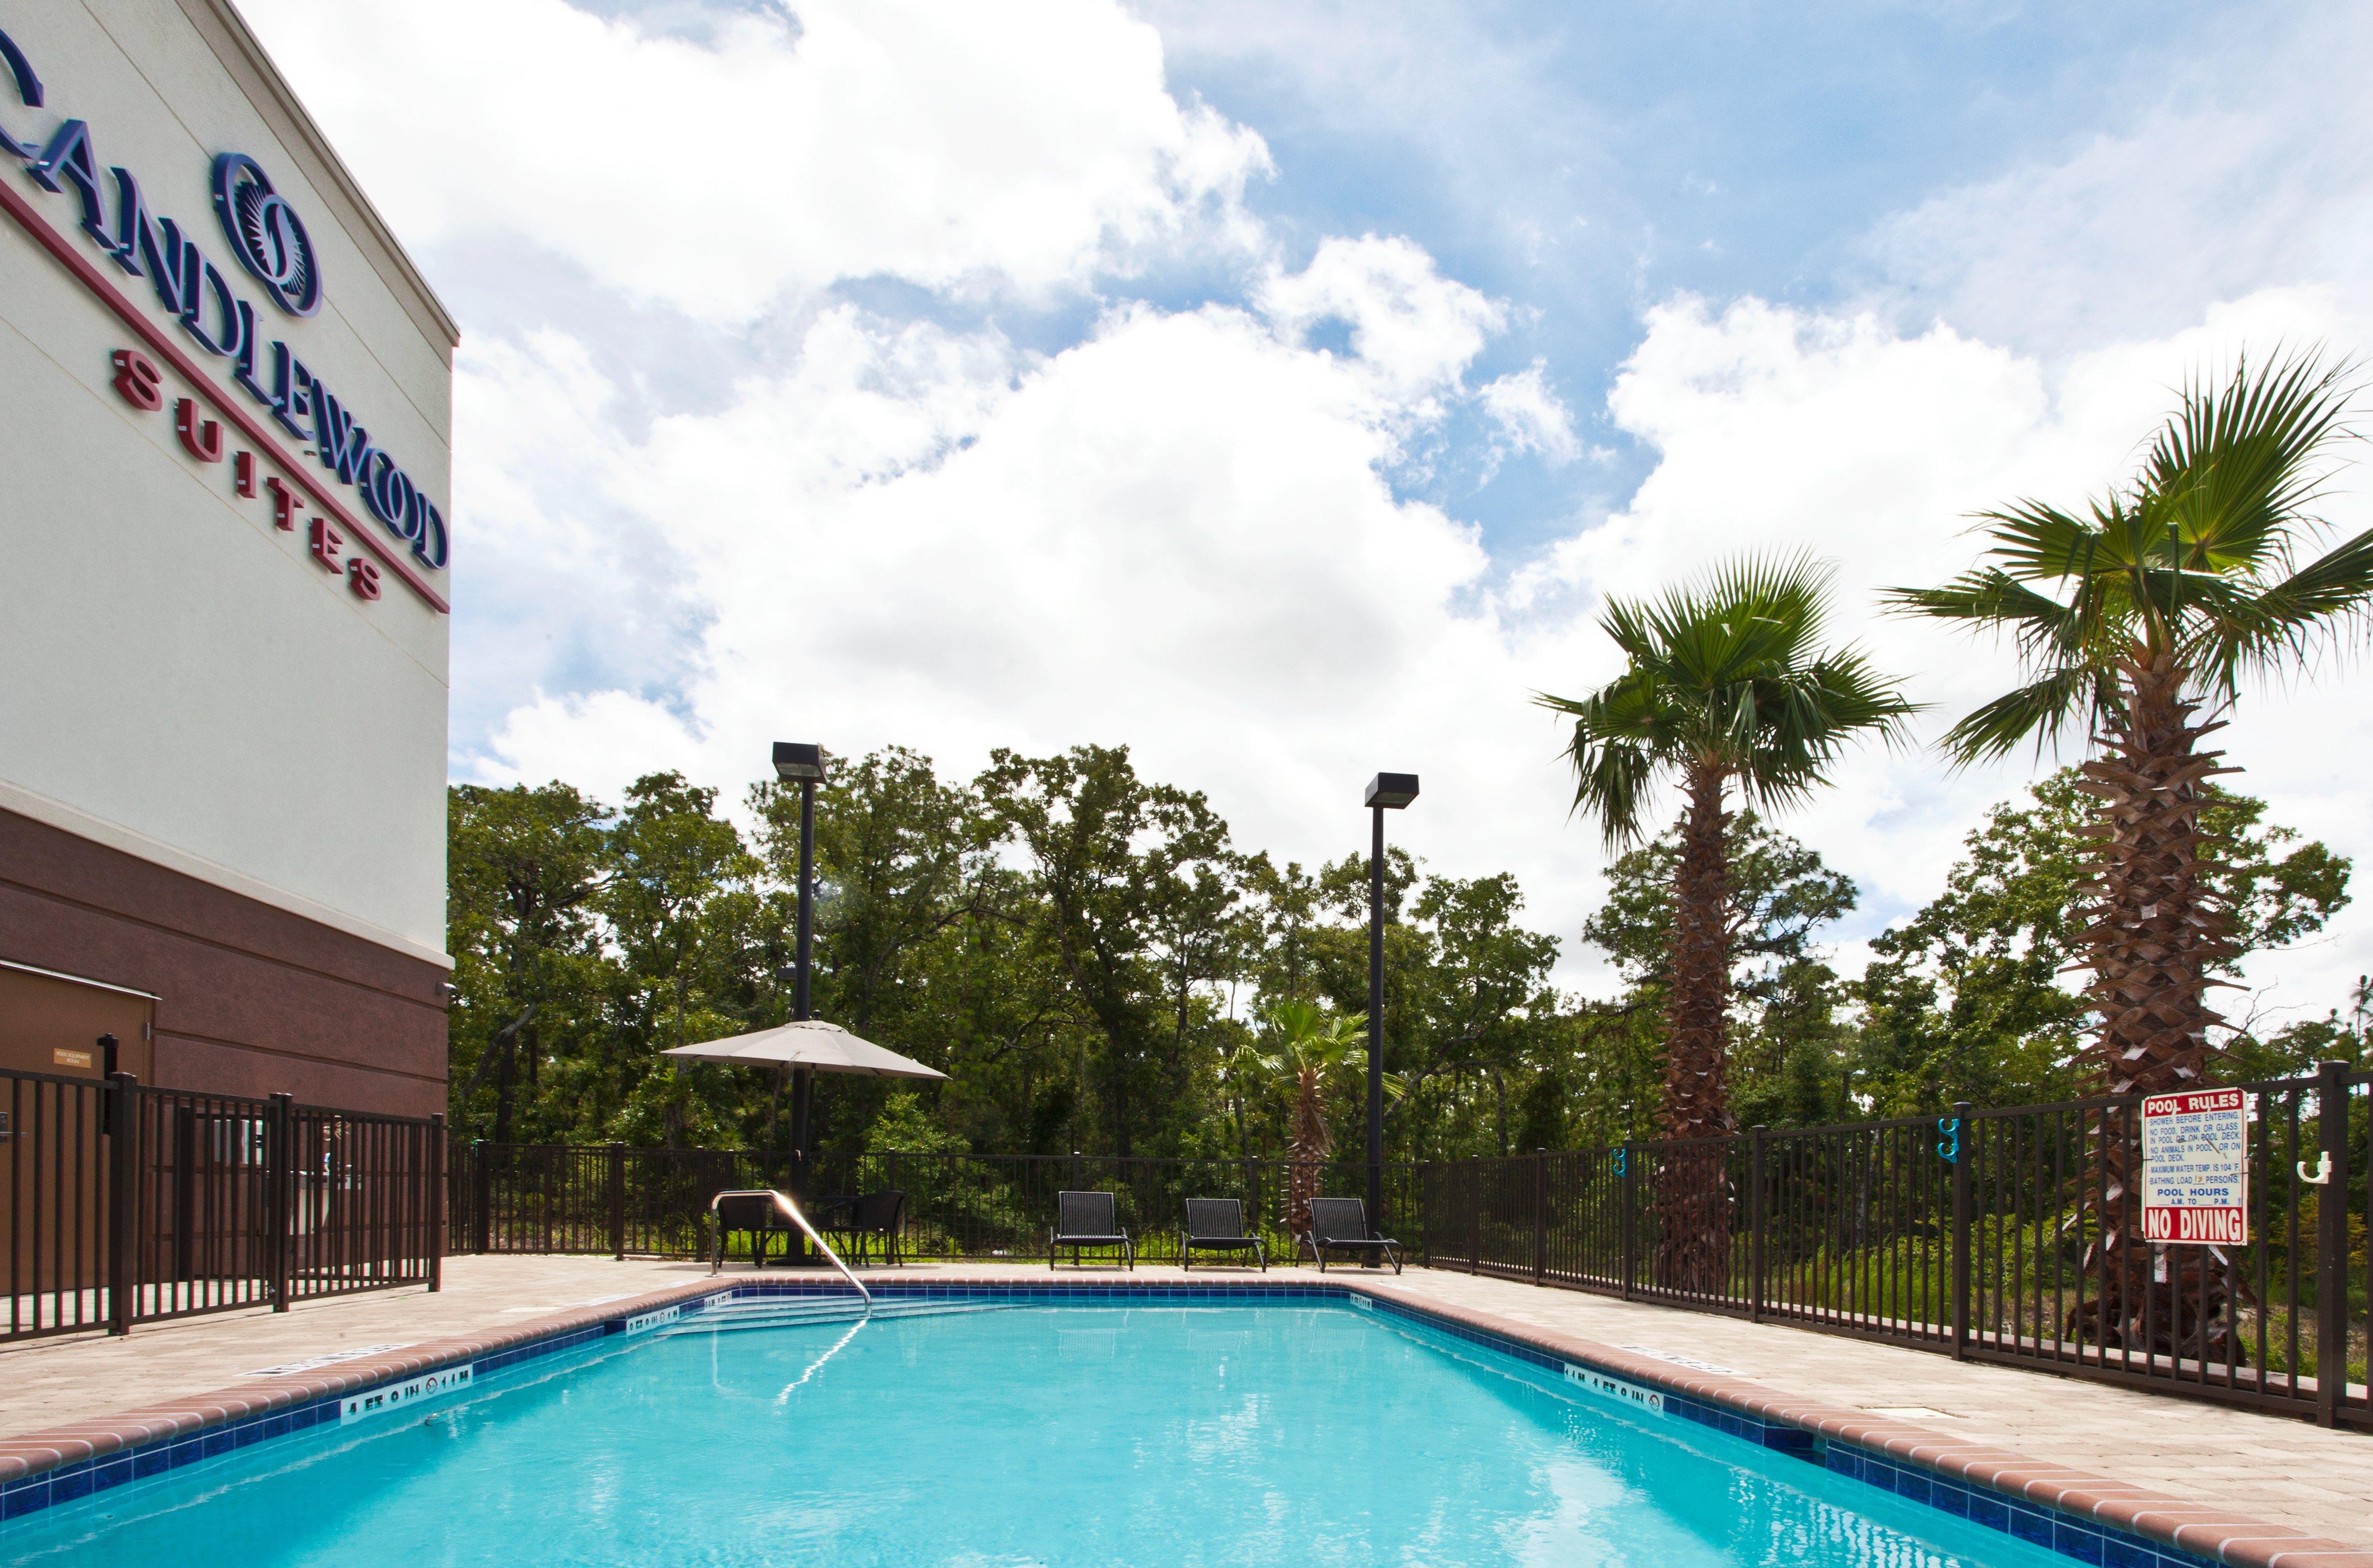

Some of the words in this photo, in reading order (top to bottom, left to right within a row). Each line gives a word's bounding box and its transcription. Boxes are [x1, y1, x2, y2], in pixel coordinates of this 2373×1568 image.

[112, 349, 381, 601] SUITES
[2148, 1099, 2181, 1114] POOL
[2189, 1093, 2239, 1110] RULES
[2150, 1117, 2173, 1126] SHOWER
[2176, 1114, 2201, 1124] BEFORE
[2205, 1111, 2239, 1121] ENTERING.
[2181, 1126, 2200, 1134] DRINK
[2216, 1123, 2238, 1131] GLASS
[2206, 1175, 2240, 1183] PERSONS.
[2148, 1209, 2172, 1239] NO
[2180, 1209, 2241, 1241] DIVING
[365, 1394, 383, 1410] FT
[405, 1384, 419, 1398] IN
[459, 1370, 469, 1381] M
[1578, 1372, 1585, 1382] M
[1603, 1381, 1616, 1393] FT
[1632, 1390, 1644, 1403] IN
